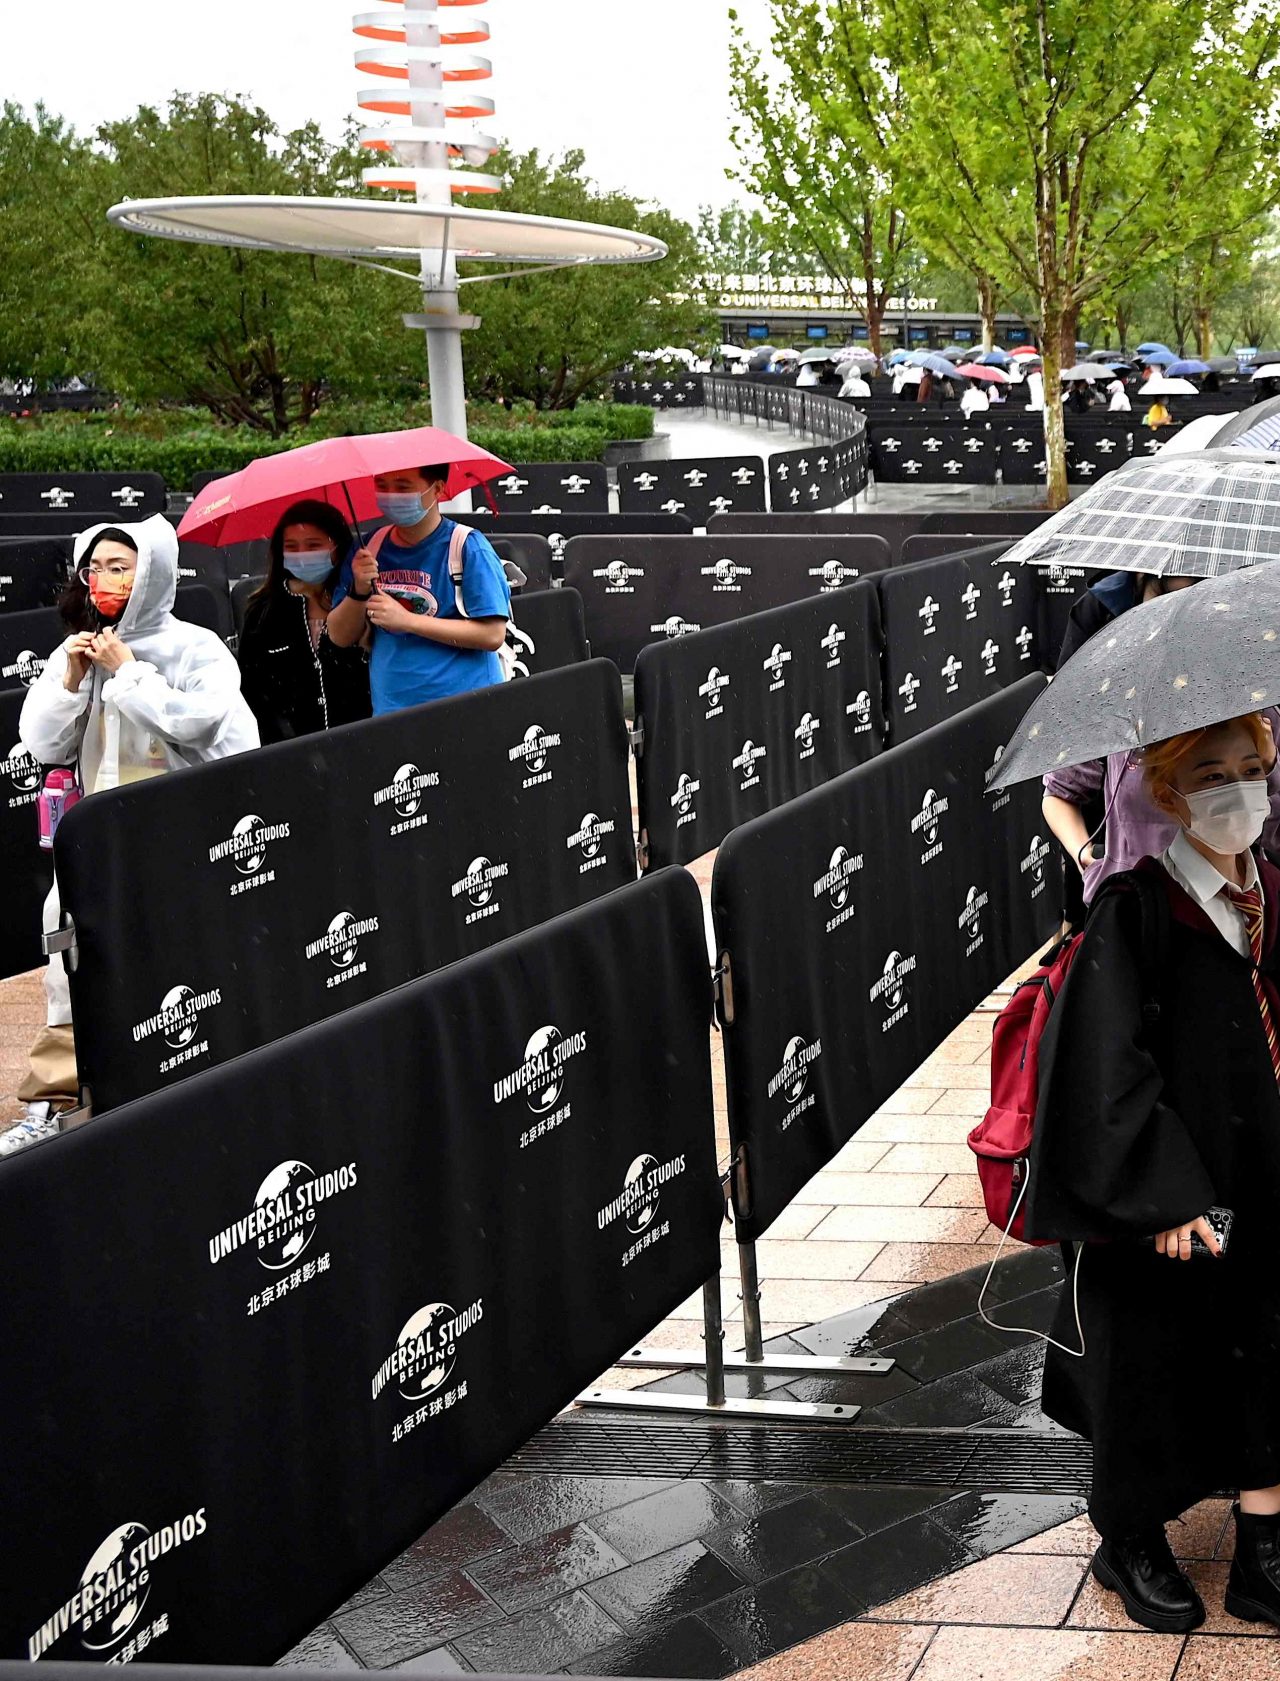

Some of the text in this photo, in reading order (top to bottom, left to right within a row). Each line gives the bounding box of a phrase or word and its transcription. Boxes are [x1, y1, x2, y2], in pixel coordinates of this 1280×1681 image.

[734, 294, 819, 308] UNIVERSAL
[376, 569, 432, 589] VOURITE
[2, 660, 32, 678] UNIVERSAL
[508, 733, 561, 761] UNIVERSAL STUDIOS
[525, 748, 547, 761] BEIJING
[0, 756, 30, 775] VERSAL
[373, 771, 440, 806] UNIVERSAL STUDIOS
[394, 789, 421, 805] BEIJING
[209, 822, 290, 862] UNIVERSAL STUDIOS
[390, 813, 428, 836] 北京环球影城
[566, 826, 593, 849] UNIVERSAL
[234, 843, 266, 860] BEIJING
[229, 870, 275, 896] 北京环球影城
[451, 862, 509, 898] UNIVERSAL STUDIOS
[468, 880, 493, 895] BEIJING
[813, 853, 864, 898] UNIVERSAL STUDIOS
[305, 916, 379, 960] UNIVERSAL STUDIOS
[330, 937, 358, 956] BEIJING
[326, 961, 367, 988] 北京环球影城
[869, 954, 917, 1003] UNIVERSAL STUDIOS
[132, 988, 221, 1042] UNIVERSAL STUDIOS
[164, 1013, 198, 1036] BEIJING
[160, 1040, 209, 1073] 北京环球影城
[493, 1031, 586, 1103] UNIVERSAL STUDIOS
[767, 1038, 822, 1098] UNIVERSAL STUDIOS
[527, 1065, 563, 1096] BEIJING
[520, 1102, 571, 1149] 北京环球影城
[597, 1154, 685, 1230] UNIVERSAL STUDIOS
[626, 1188, 659, 1219] BEIJING
[209, 1162, 357, 1264] UNIVERSAL STUDIOS
[258, 1209, 316, 1250] BEIJING
[621, 1220, 670, 1267] 北京环球影城
[247, 1252, 331, 1316] 北京环球影城
[371, 1298, 483, 1400] UNIVERSAL STUDIOS
[399, 1343, 456, 1383] BEIJING
[392, 1380, 468, 1442] 北京环球影城
[28, 1508, 207, 1663] UNIVERSAL STUDIOS
[82, 1570, 149, 1632] BEIJING
[104, 1613, 170, 1665] 球影城
